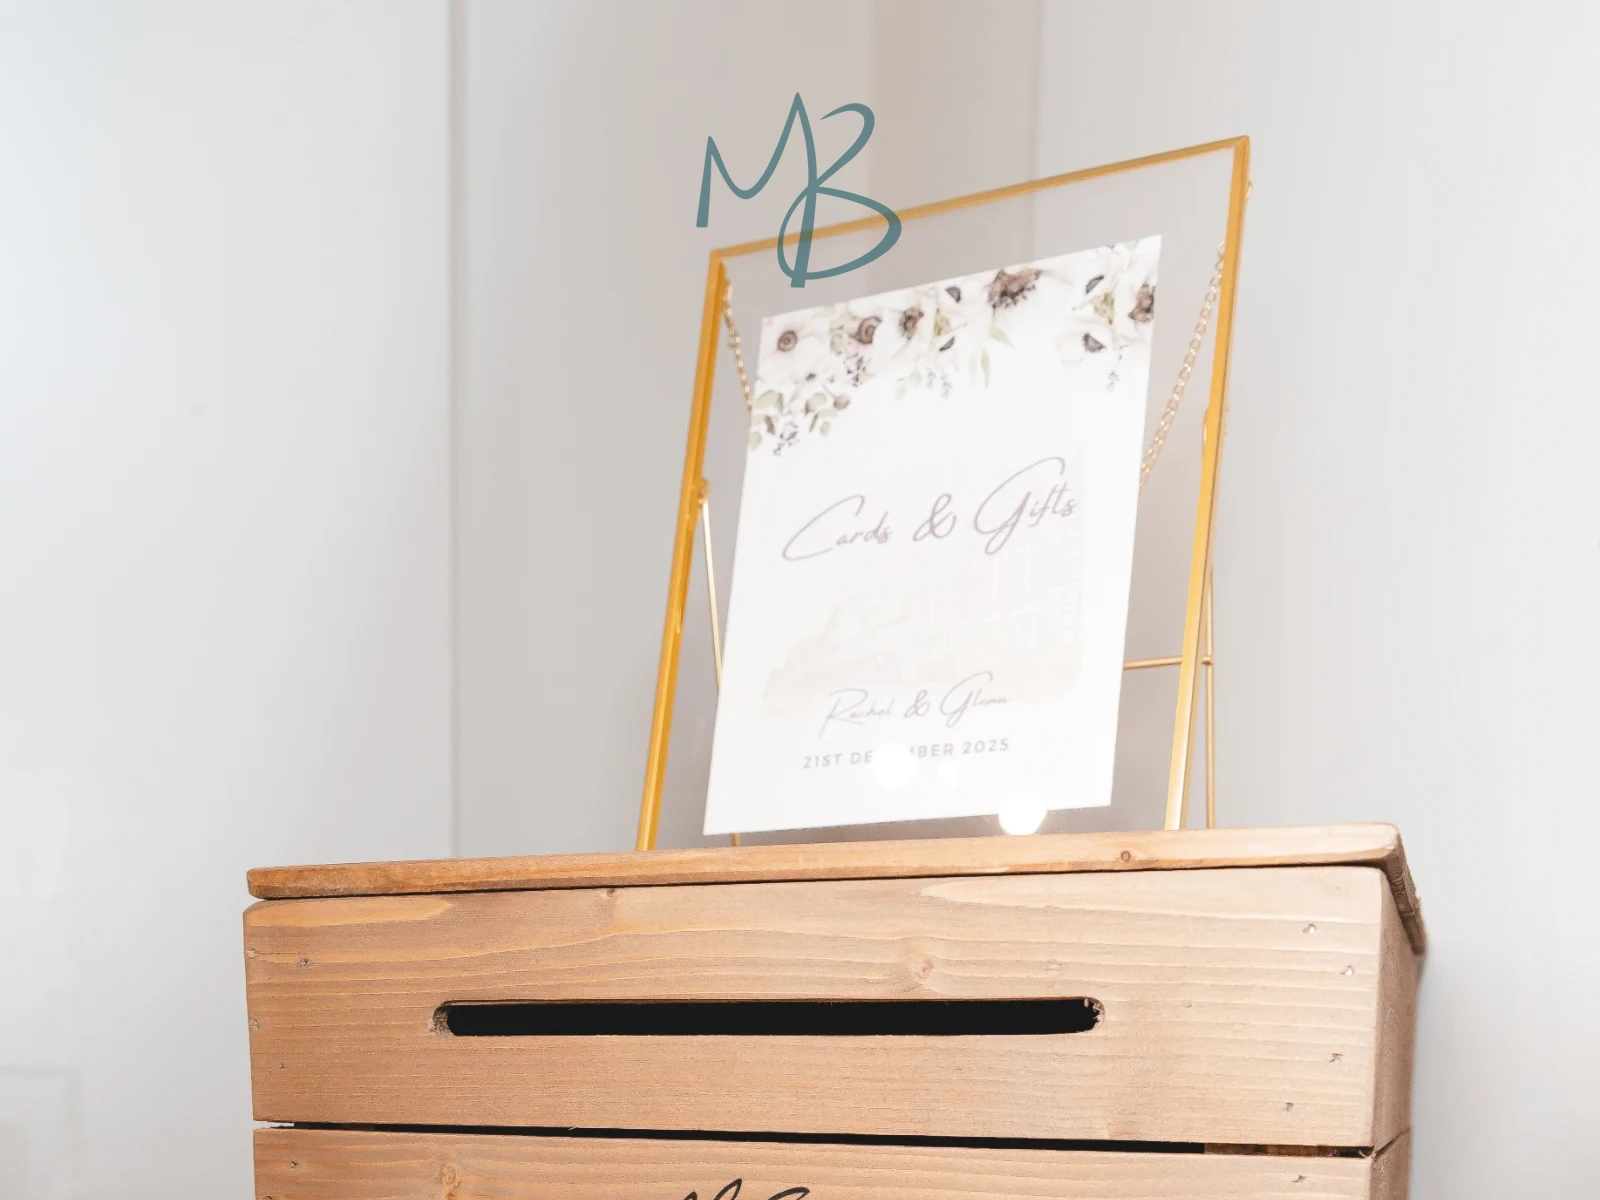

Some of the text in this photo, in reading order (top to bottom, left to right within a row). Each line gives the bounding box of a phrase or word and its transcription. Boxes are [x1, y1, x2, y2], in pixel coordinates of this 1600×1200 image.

[782, 457, 1079, 561] Cards & Gifts
[818, 670, 1010, 739] Rachel & Glenn
[802, 738, 1010, 770] 21ST DEBER 2025
